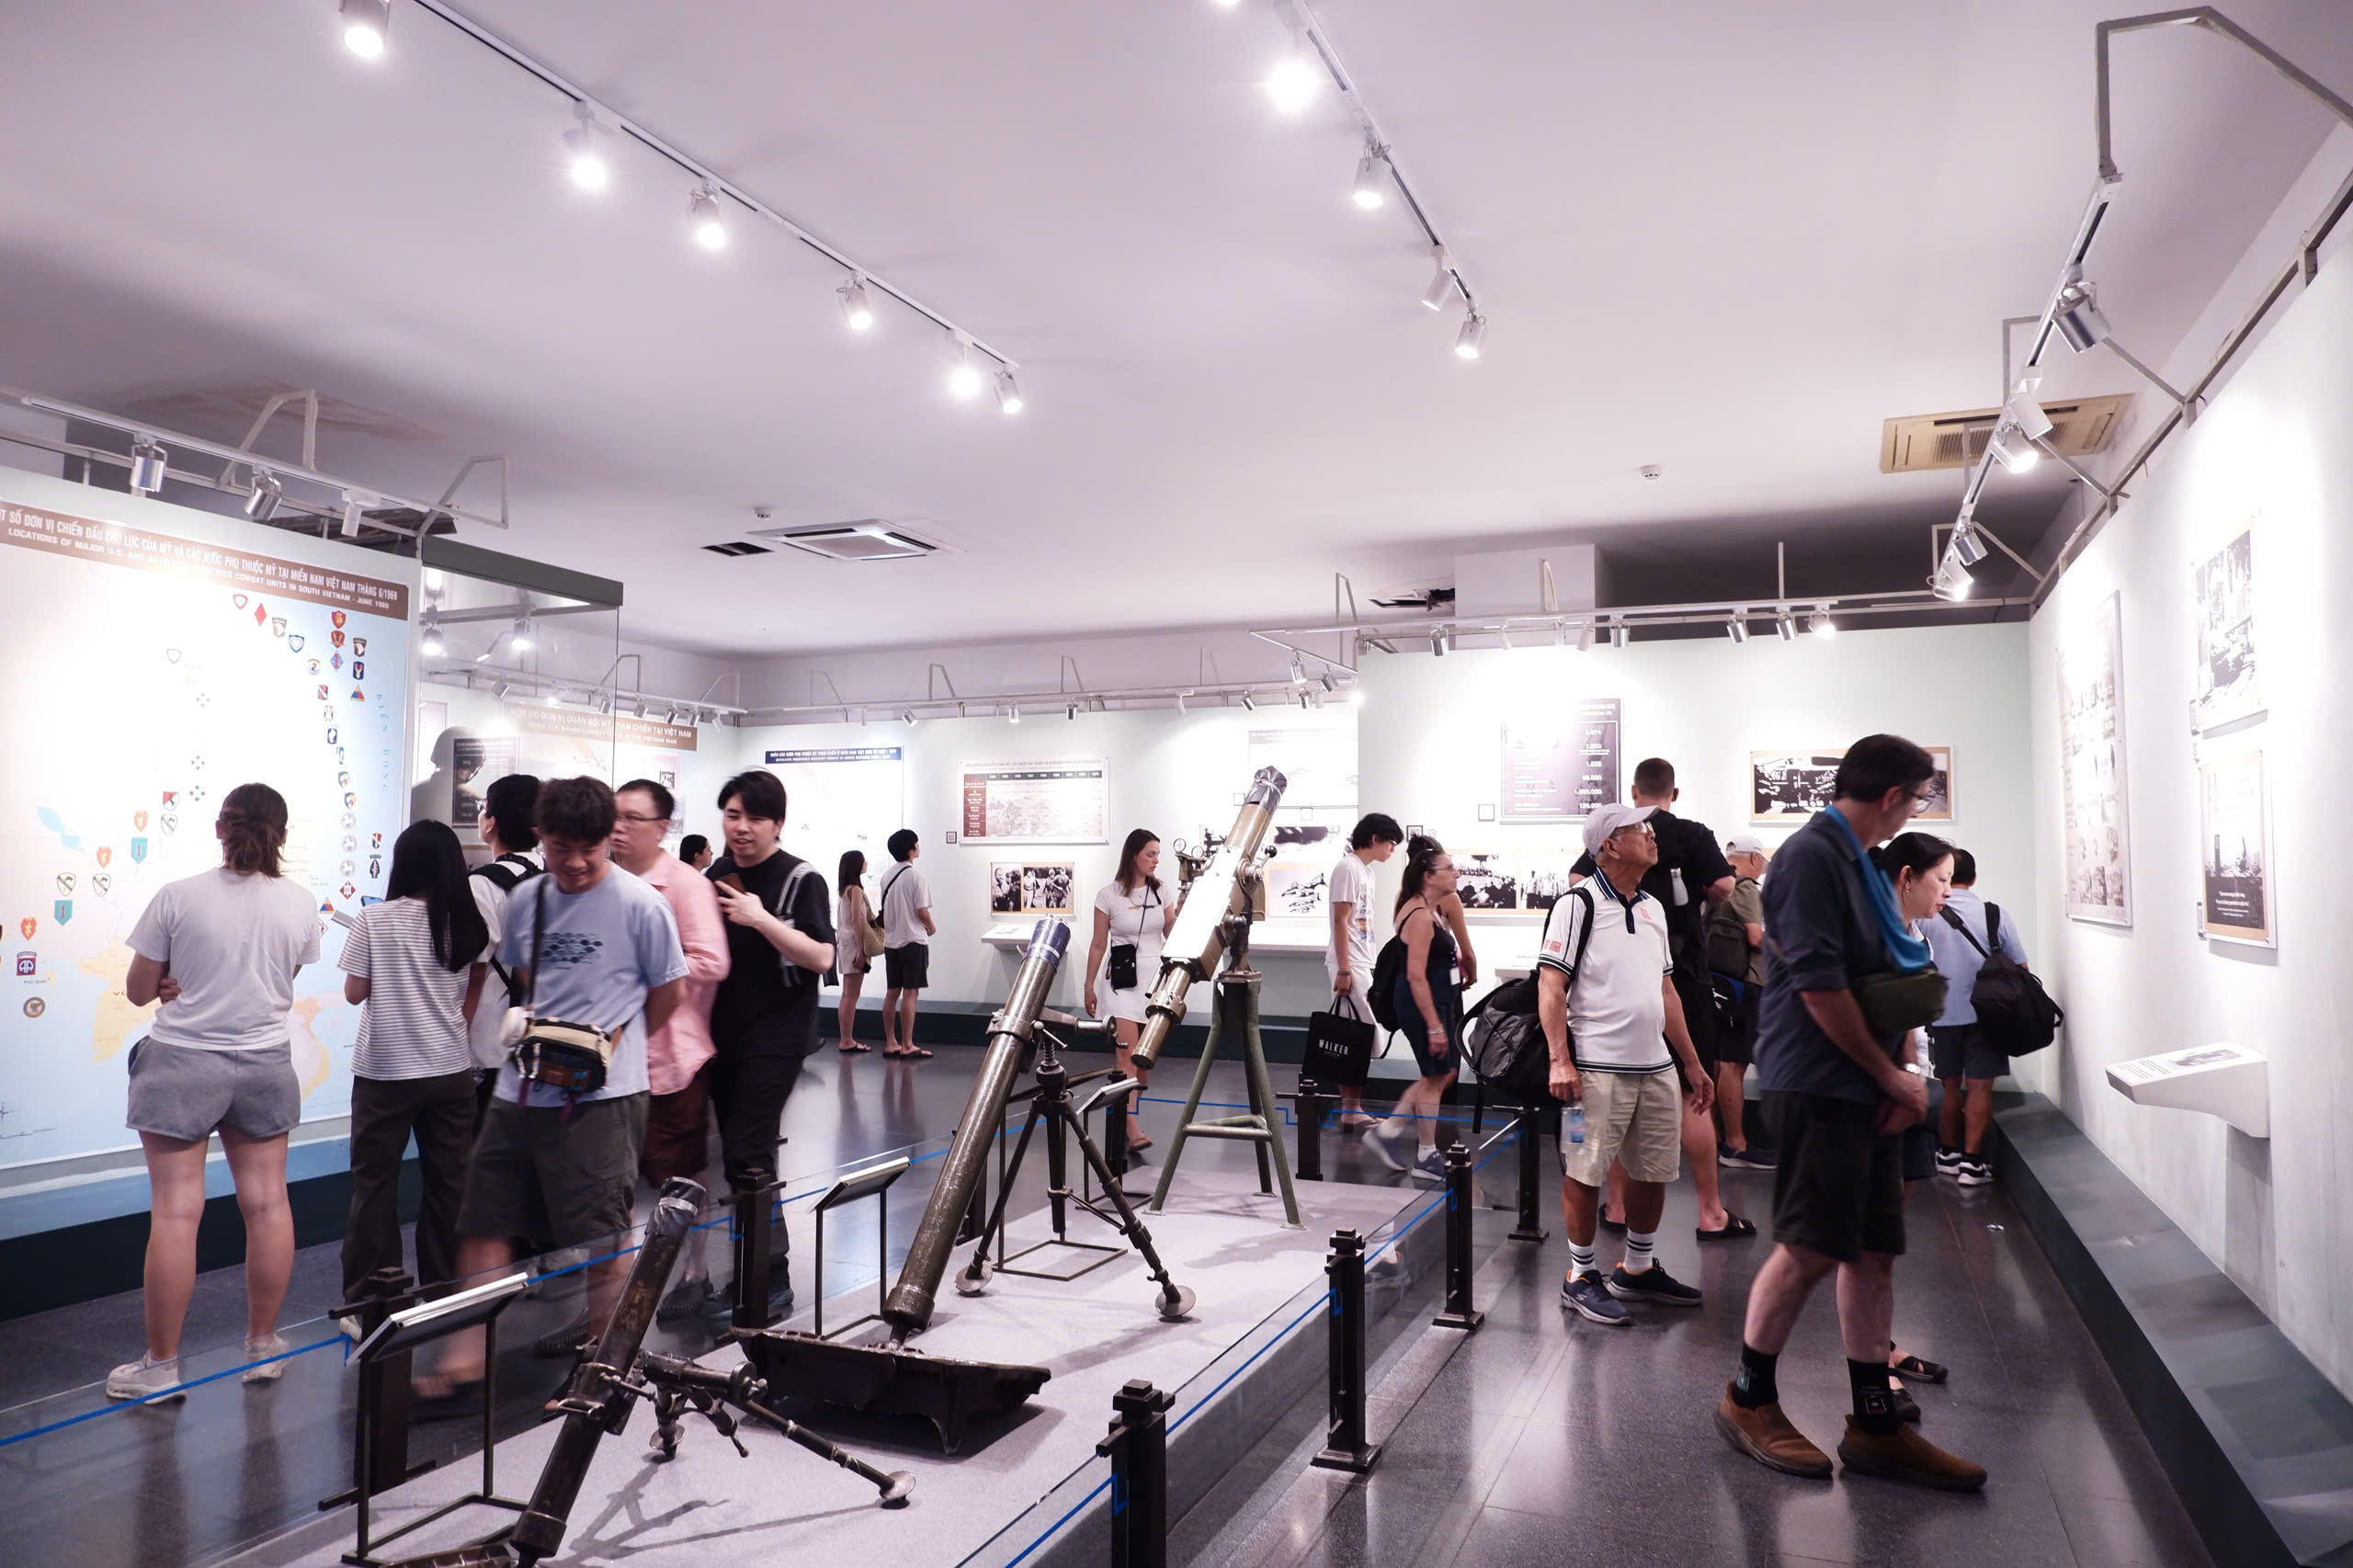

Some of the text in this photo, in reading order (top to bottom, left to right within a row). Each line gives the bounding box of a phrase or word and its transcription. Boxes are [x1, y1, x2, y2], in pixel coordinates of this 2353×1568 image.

[8, 527, 59, 544] LOCATIONS
[61, 537, 73, 547] OF
[74, 540, 105, 553] MAJOR
[235, 572, 264, 585] COMBAT
[267, 579, 287, 589] UNITS
[299, 584, 320, 597] SOUTH
[322, 589, 350, 602] VIETNAM
[9, 508, 22, 524] SỐ
[24, 514, 43, 530] ĐƠN
[46, 518, 55, 533] VỊ
[57, 520, 83, 537] CHIẾN
[142, 537, 157, 552] CỦA
[224, 555, 240, 570] PHỤ
[242, 558, 264, 574] THUỘC
[266, 562, 277, 576] MỸ
[278, 566, 290, 580] TẠI
[290, 568, 308, 583] MIỀN
[310, 574, 324, 586] NAM
[325, 575, 340, 590] VIỆT
[342, 581, 356, 593] NAM
[358, 583, 377, 597] THÁNG
[566, 713, 586, 726] QUÂN
[664, 727, 677, 738] VIỆT
[678, 731, 692, 739] NAM
[1318, 1039, 1348, 1055] WALKER
